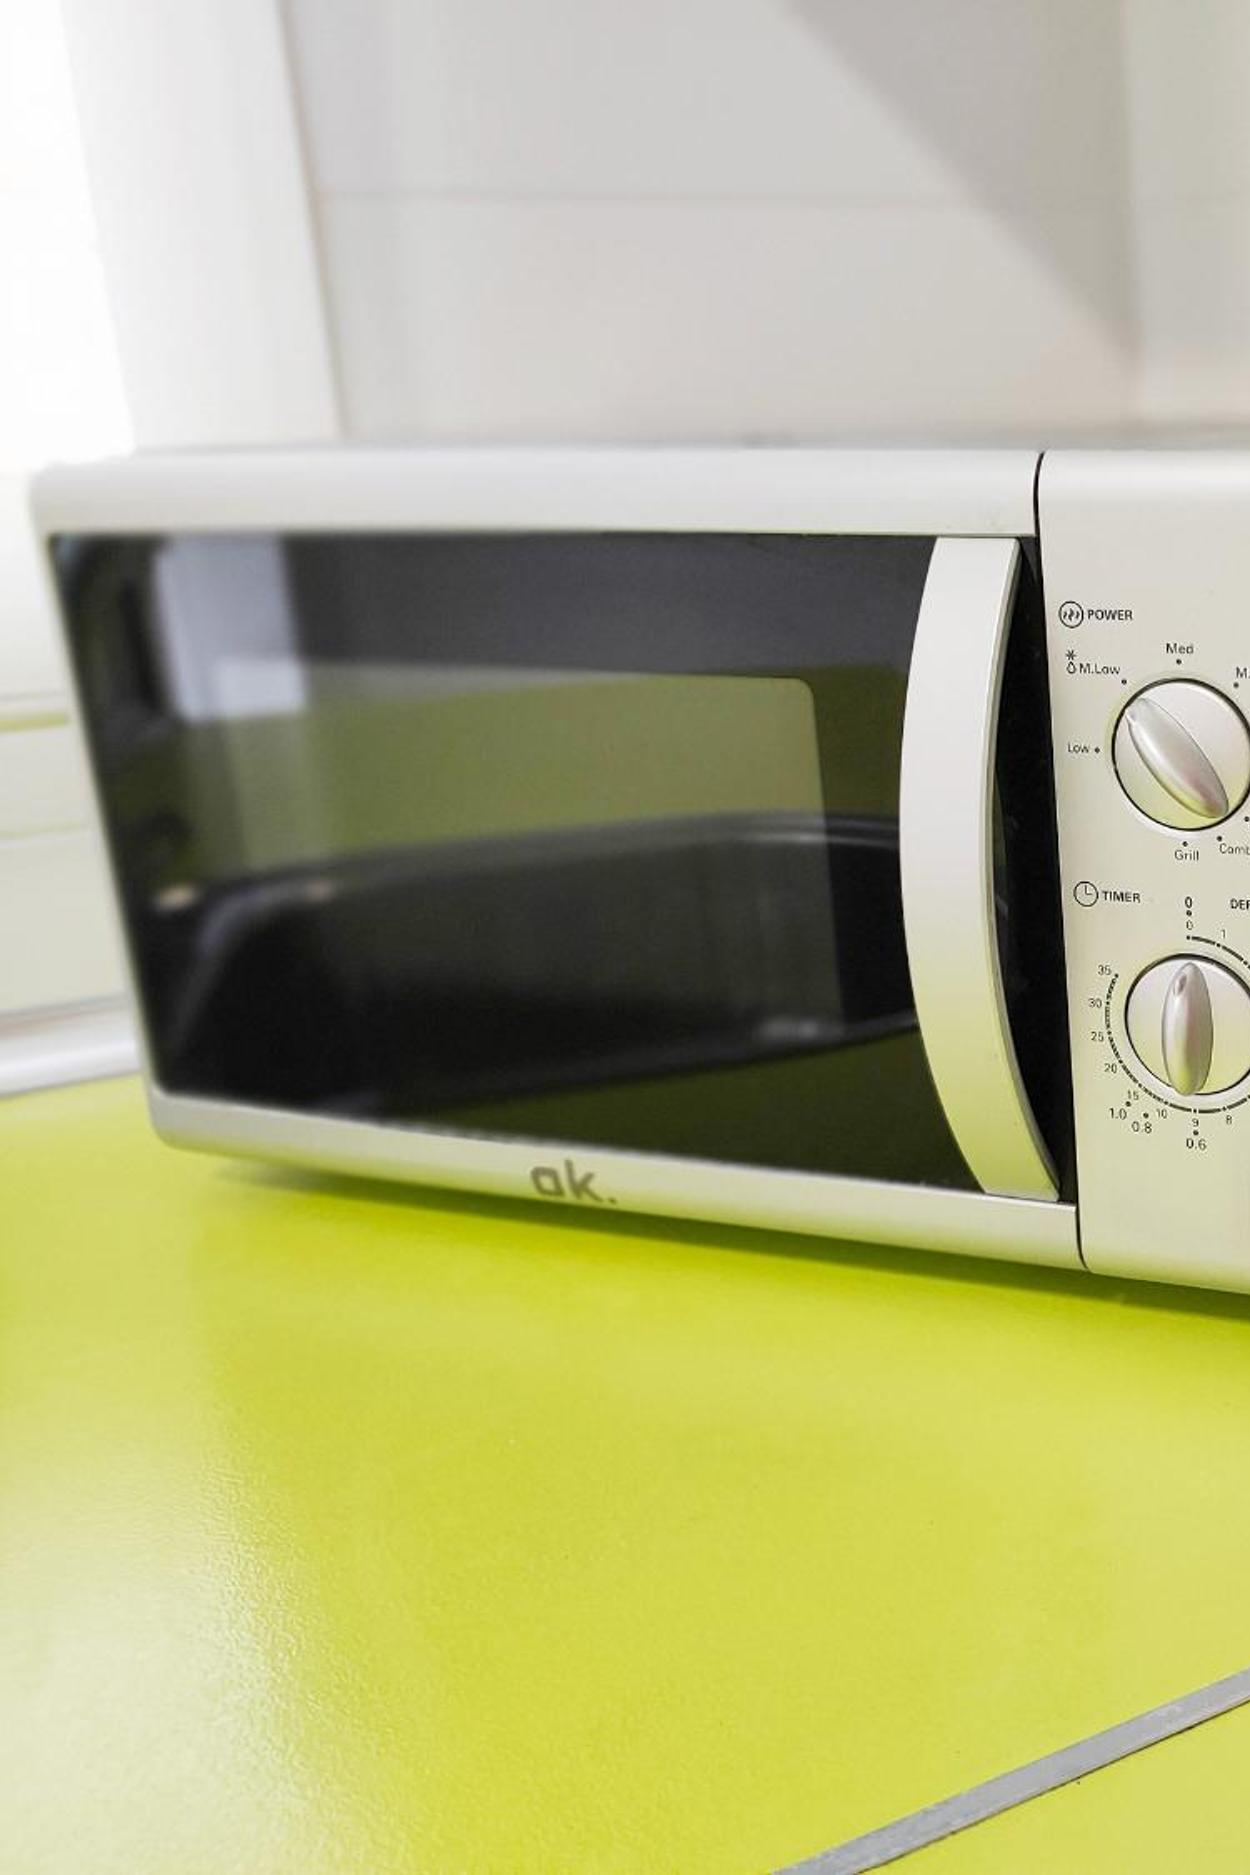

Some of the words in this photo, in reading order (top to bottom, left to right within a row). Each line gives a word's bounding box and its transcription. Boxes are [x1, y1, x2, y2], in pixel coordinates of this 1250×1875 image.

[1087, 609, 1134, 621] POWER
[1166, 643, 1194, 655] Med
[1079, 663, 1121, 675] M.Low
[1067, 744, 1090, 754] Low
[1174, 850, 1200, 861] Grill
[1101, 890, 1141, 903] TIMER
[1184, 897, 1193, 909] 0
[1186, 920, 1194, 931] 0
[1221, 929, 1226, 939] 1
[1098, 965, 1111, 976] 35
[1088, 998, 1102, 1009] 30
[1091, 1032, 1104, 1042] 25
[1104, 1064, 1117, 1073] 20
[1127, 1090, 1139, 1101] 15
[1109, 1108, 1127, 1119] 1.0
[1156, 1109, 1167, 1119] 10
[1191, 1118, 1199, 1128] 9
[1226, 1116, 1232, 1125] 8
[1131, 1122, 1152, 1134] 0.8
[1186, 1139, 1207, 1150] 0.6
